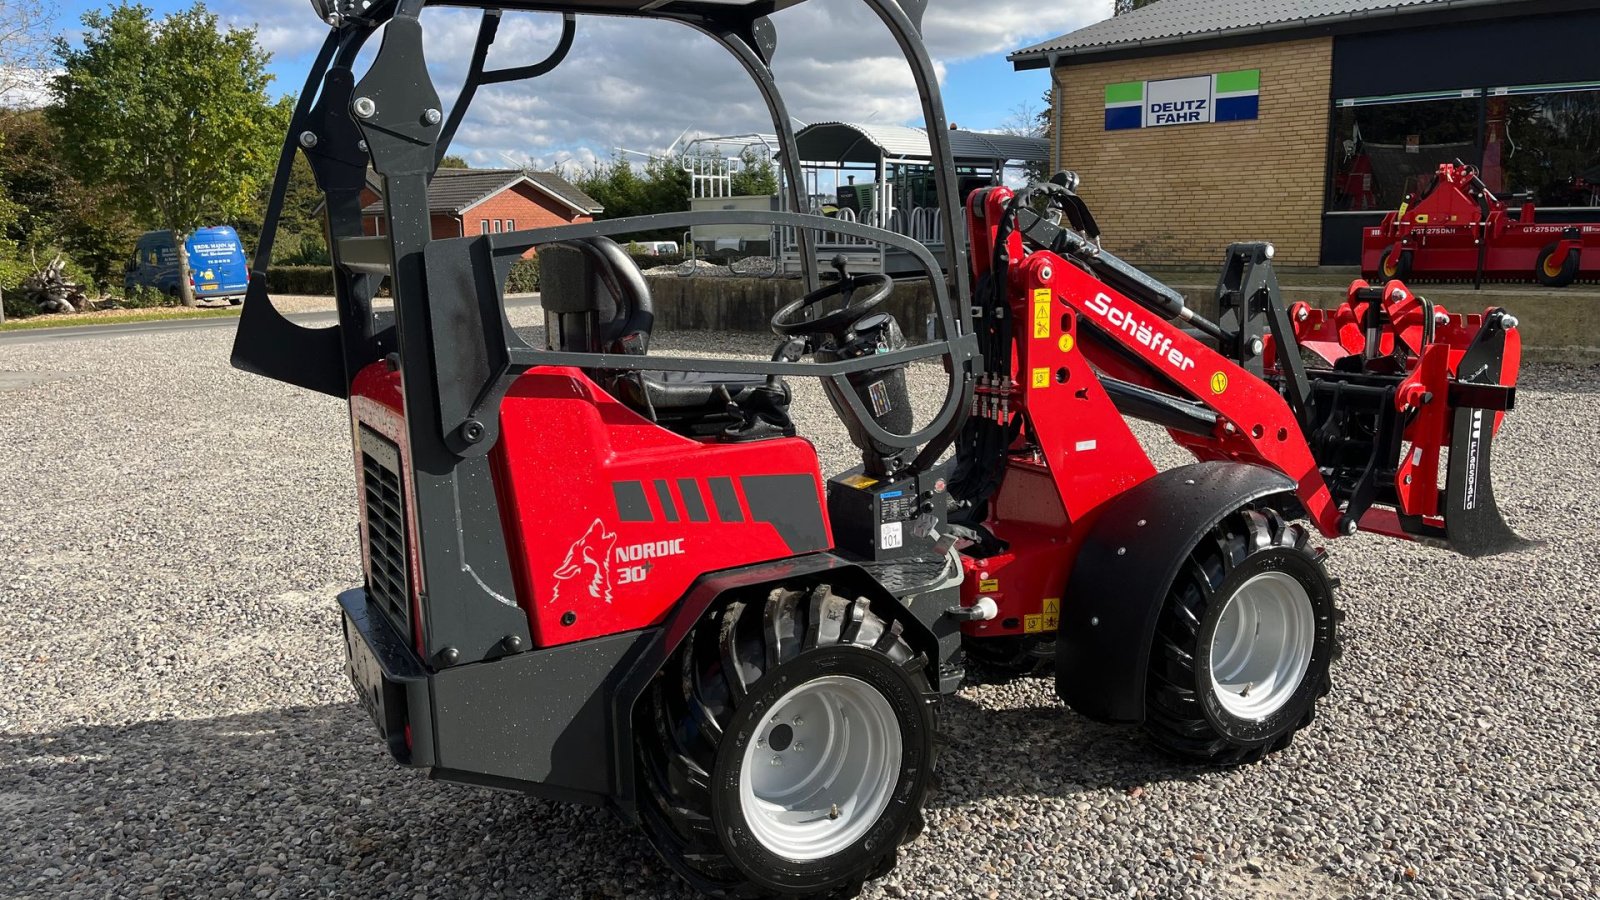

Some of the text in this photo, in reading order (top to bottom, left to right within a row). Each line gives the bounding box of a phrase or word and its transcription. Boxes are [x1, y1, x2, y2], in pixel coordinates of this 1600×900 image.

[1151, 99, 1206, 113] DEUTZ
[1156, 111, 1201, 124] FAHR
[1084, 292, 1195, 372] Schäffer
[883, 534, 897, 547] 101
[615, 538, 685, 563] NORDIC
